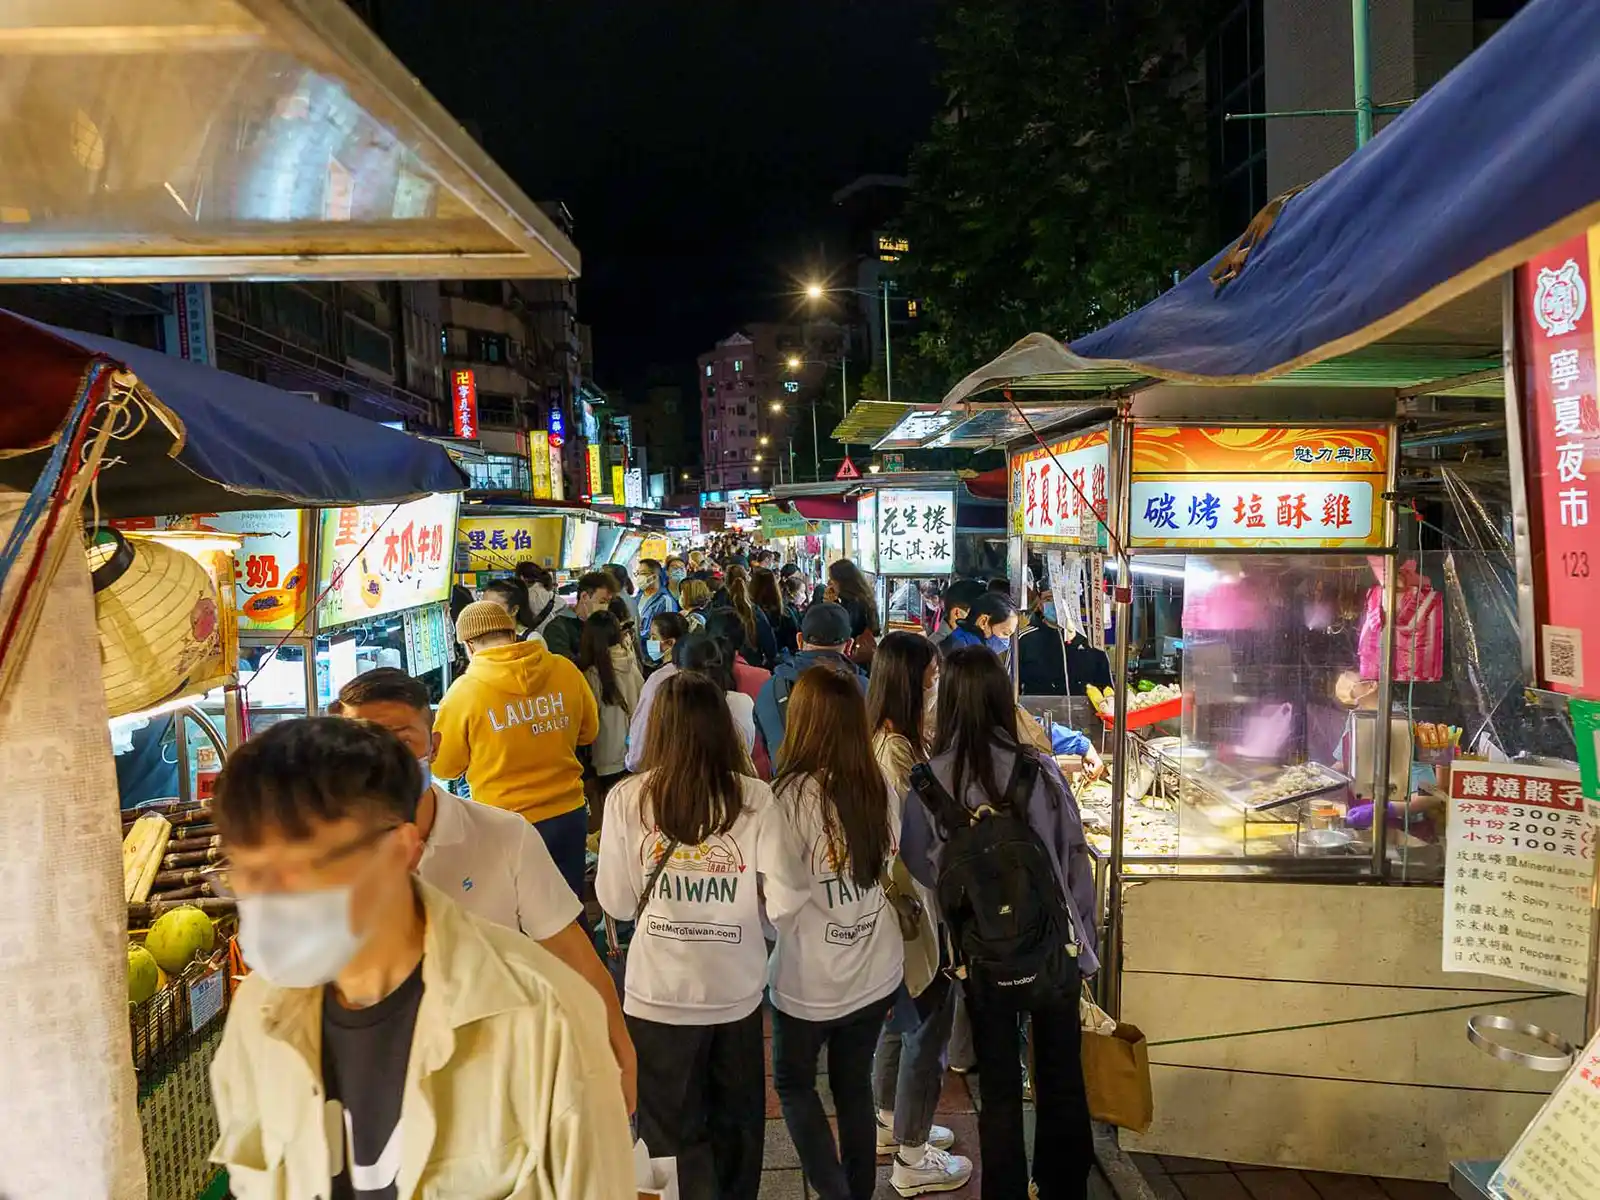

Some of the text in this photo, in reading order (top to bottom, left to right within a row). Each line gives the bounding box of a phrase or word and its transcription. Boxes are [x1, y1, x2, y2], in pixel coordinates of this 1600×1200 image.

[1547, 348, 1589, 528] 寧夏夜市
[1293, 446, 1375, 464] 魅力無限
[880, 504, 952, 536] 花生捲
[1143, 491, 1353, 530] 碳烤塩酥雞
[383, 519, 443, 576] 木瓜牛奶
[468, 528, 532, 551] 里長伯
[879, 538, 951, 561] 冰淇淋
[1561, 551, 1590, 578] 123
[487, 691, 565, 732] LAUGH
[532, 715, 569, 735] DEALER
[1518, 860, 1556, 873] Mineral
[1522, 895, 1550, 909] Spicy
[1522, 912, 1554, 927] Cumin
[1519, 945, 1554, 961] Pepper
